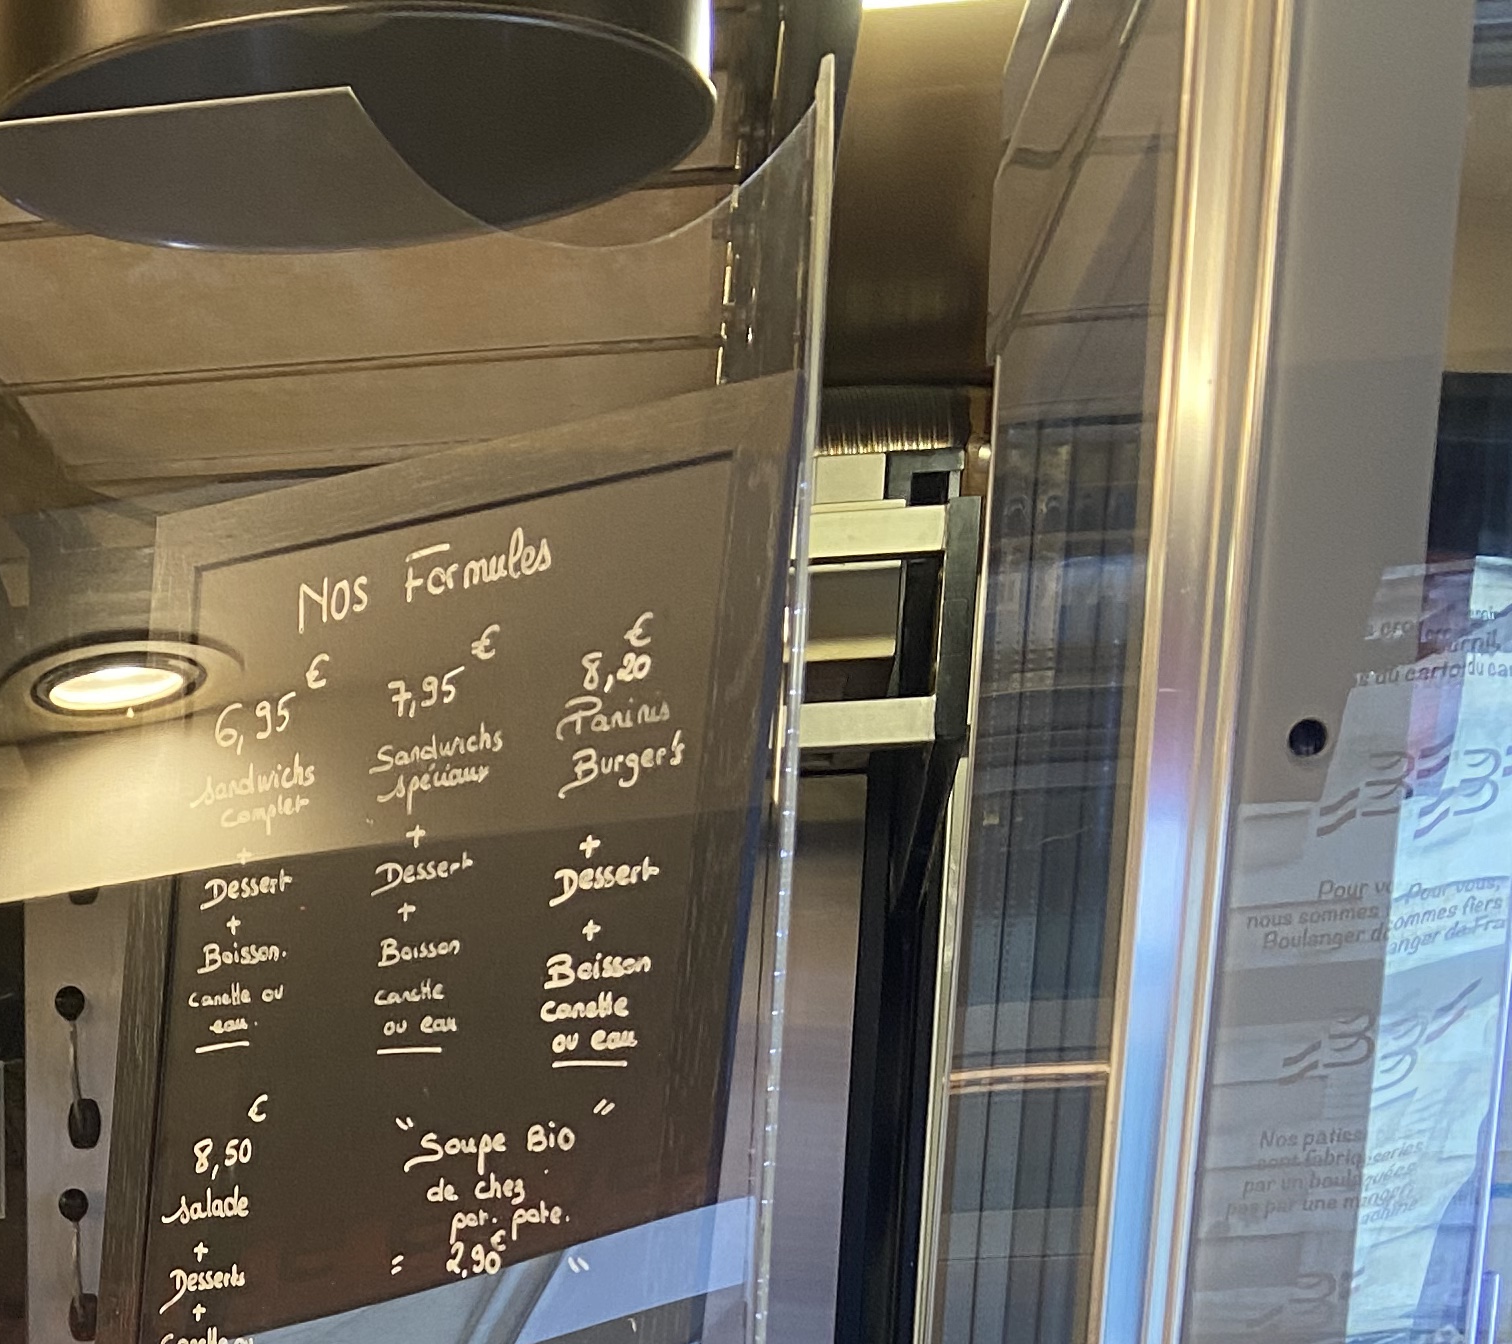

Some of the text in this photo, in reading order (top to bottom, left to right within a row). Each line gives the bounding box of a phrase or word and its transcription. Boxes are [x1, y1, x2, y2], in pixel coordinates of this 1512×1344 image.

[404, 527, 552, 602] Formules
[200, 868, 292, 911] Dessert
[370, 851, 474, 897] Dessert
[548, 856, 660, 907] Dessert
[377, 937, 460, 967] Boisson
[544, 952, 652, 990] Boisson
[261, 984, 284, 1004] ou
[383, 1015, 458, 1036] ou eau
[552, 1029, 638, 1054] ou eau
[426, 1177, 459, 1202] de
